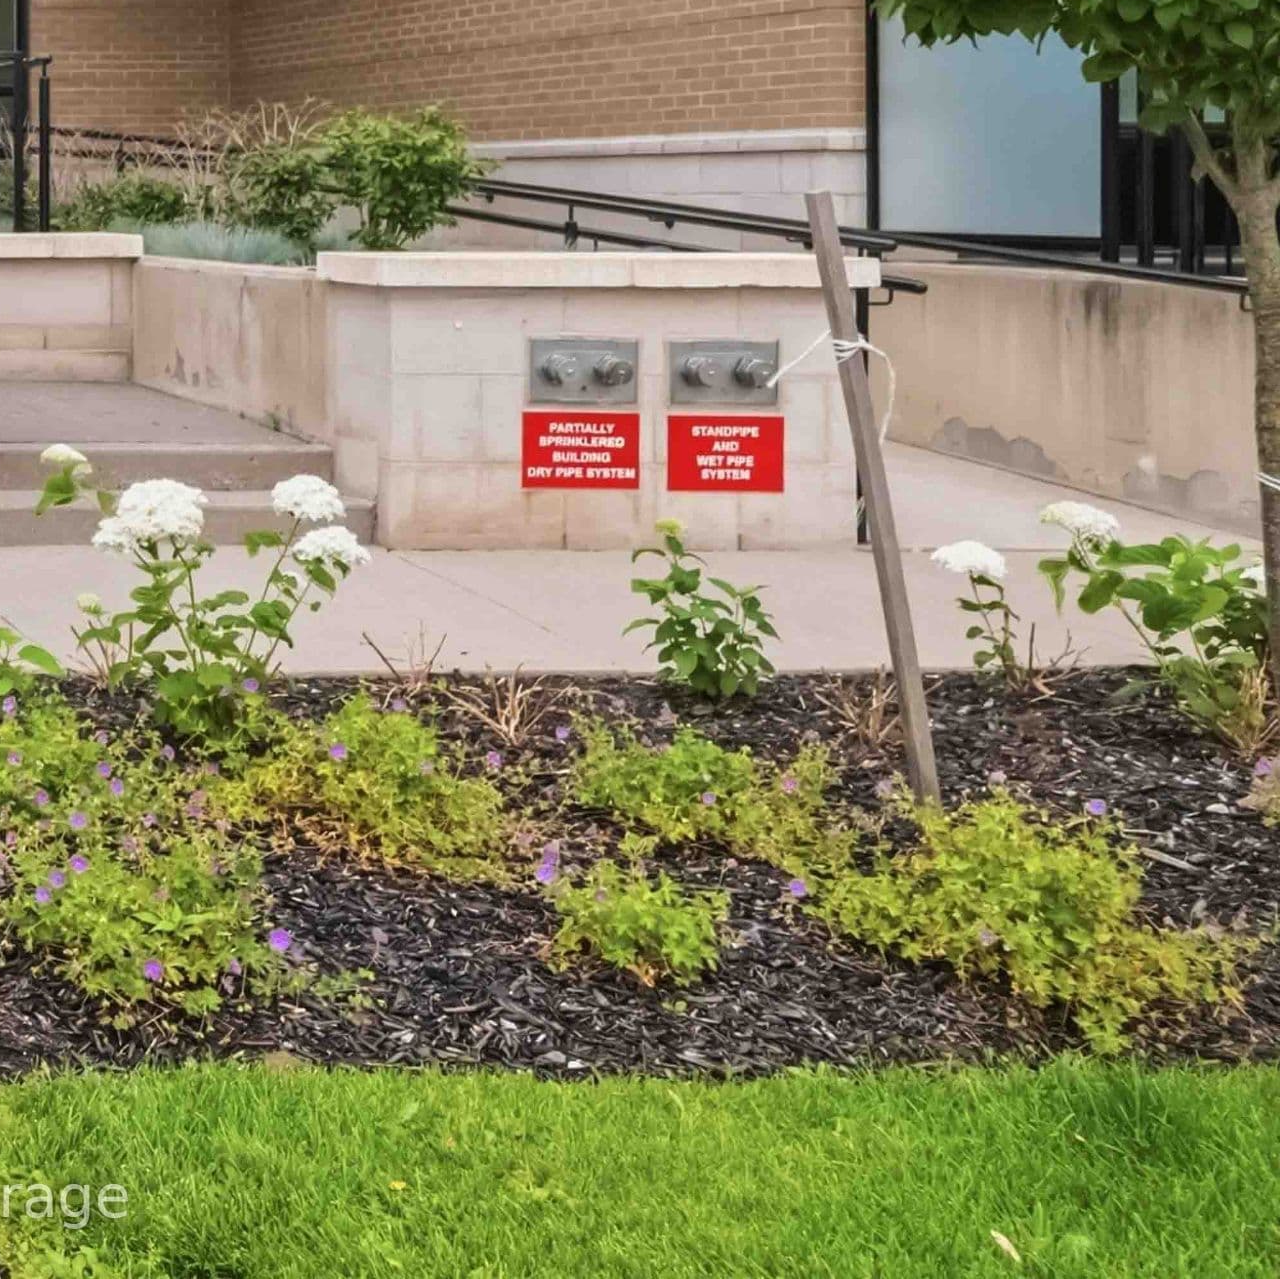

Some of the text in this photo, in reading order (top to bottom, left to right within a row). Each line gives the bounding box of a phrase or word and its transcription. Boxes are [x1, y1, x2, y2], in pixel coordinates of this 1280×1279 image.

[549, 422, 616, 434] PARTIALLY
[691, 425, 760, 438] STANDPIPE
[539, 435, 625, 448] SPRINKLERED
[712, 441, 740, 452] AND
[552, 451, 611, 463] BUILDING
[696, 455, 755, 467] WET PIPE
[527, 467, 636, 479] DRY PIPE SYSTEM
[701, 468, 751, 480] SYSTEM
